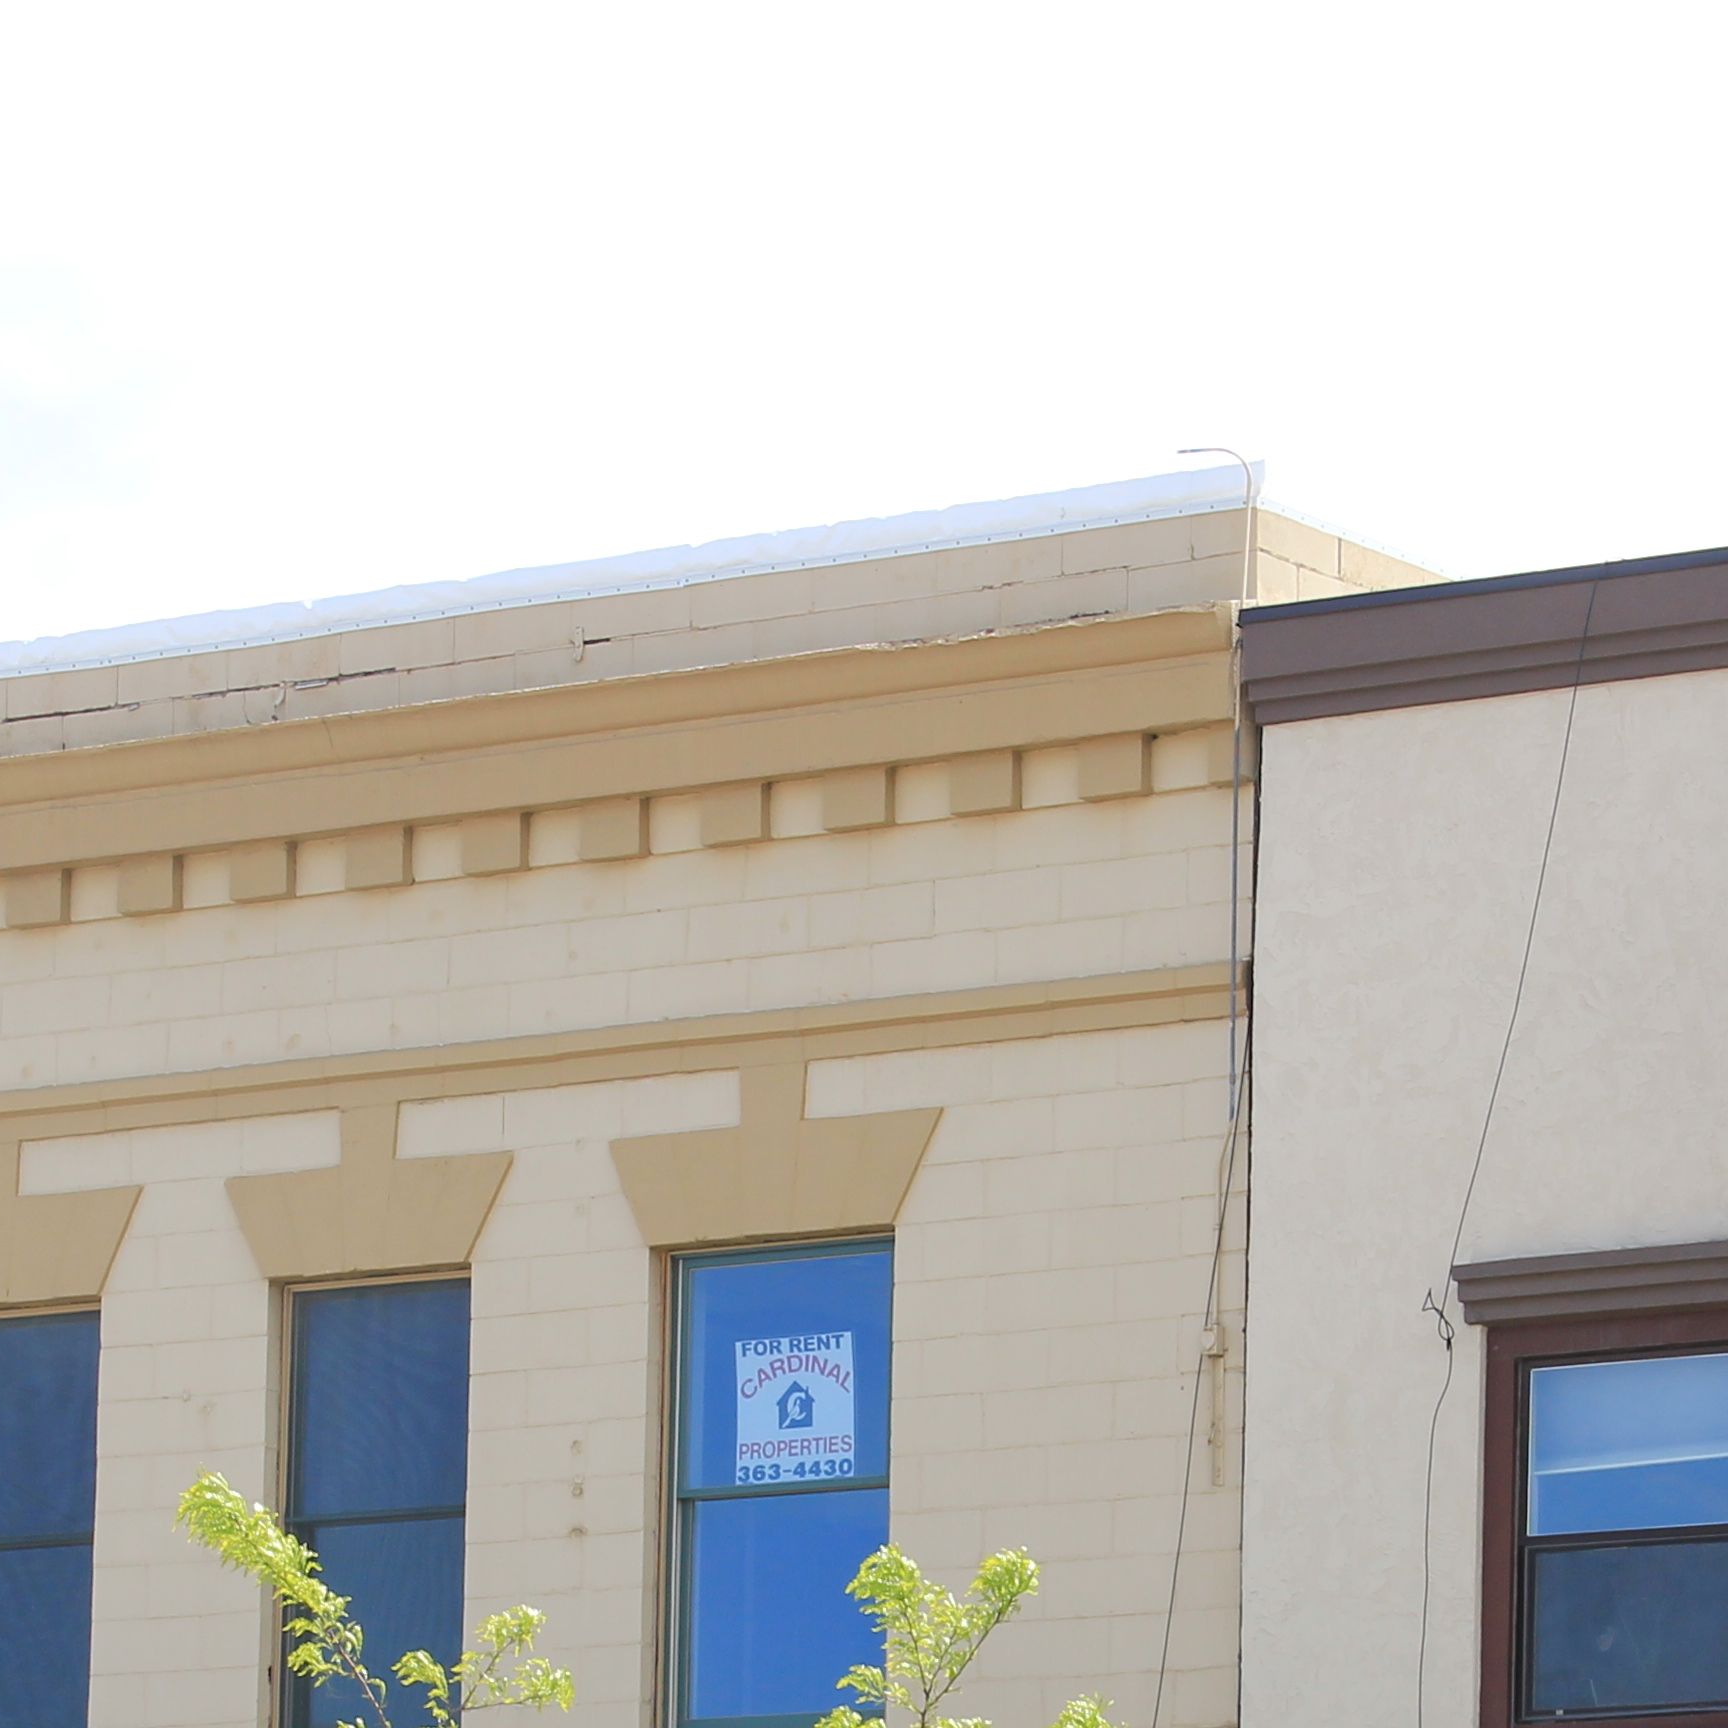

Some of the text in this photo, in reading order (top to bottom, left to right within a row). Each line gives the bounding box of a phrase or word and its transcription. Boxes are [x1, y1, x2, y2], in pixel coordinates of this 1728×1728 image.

[741, 1334, 845, 1357] FOR RENT
[740, 1354, 853, 1399] CARDINAL
[739, 1435, 853, 1460] PROPERTIES
[738, 1458, 853, 1482] 363-4430
